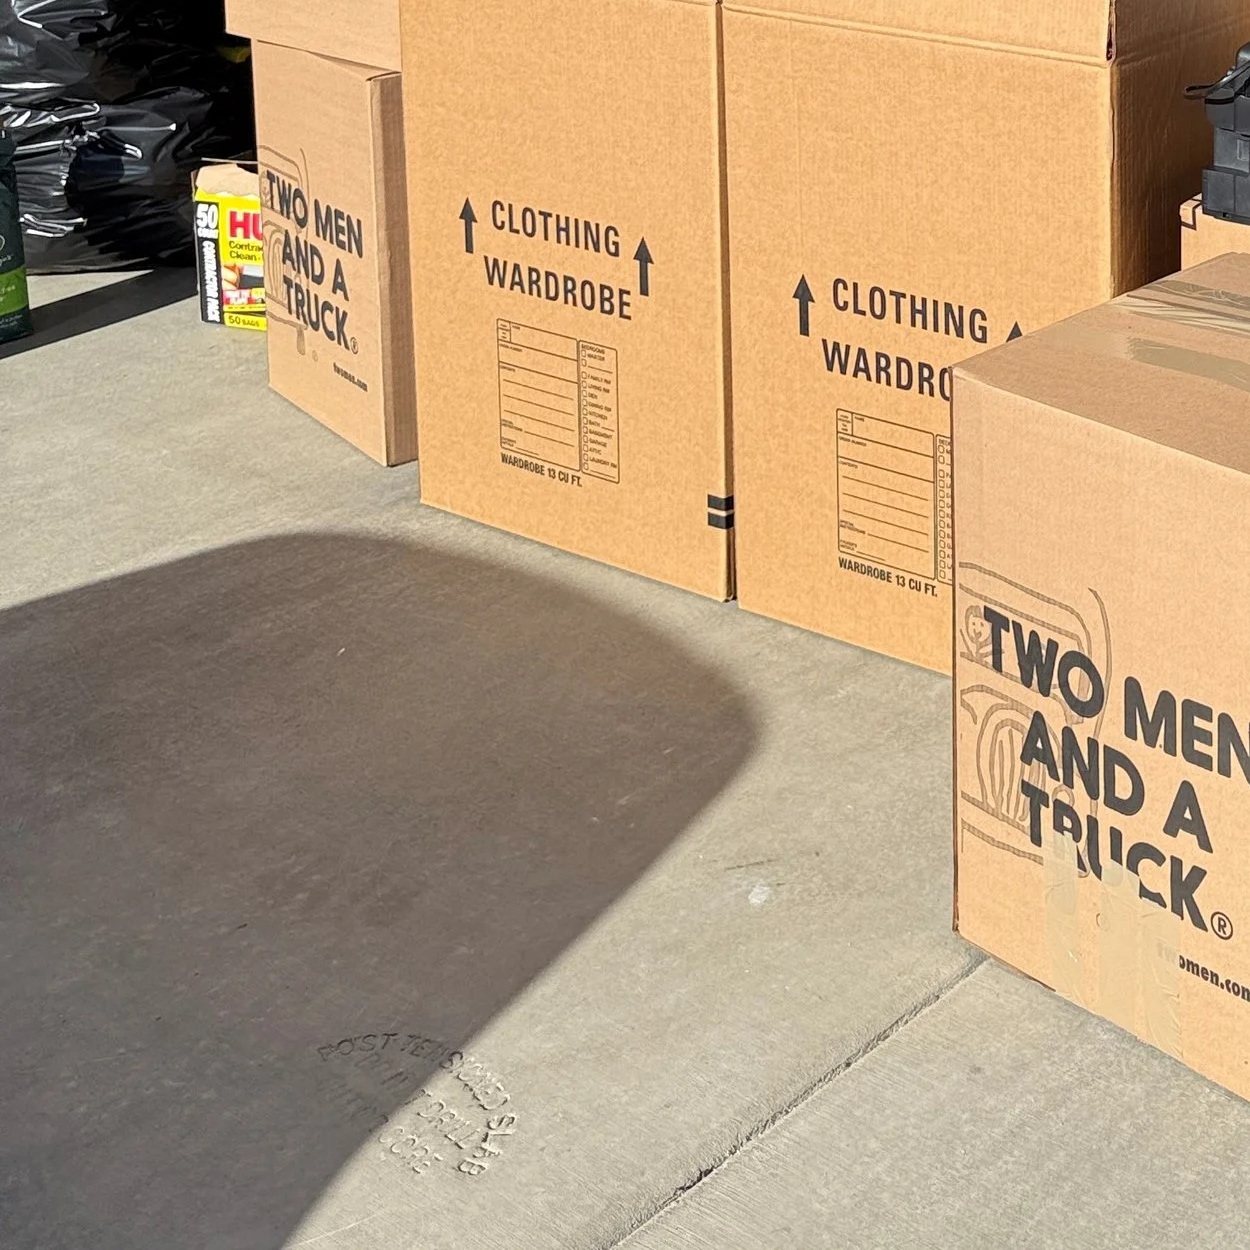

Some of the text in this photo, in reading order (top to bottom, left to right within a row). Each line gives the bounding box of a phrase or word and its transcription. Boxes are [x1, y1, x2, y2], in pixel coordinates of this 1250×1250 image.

[196, 203, 219, 229] 50
[266, 170, 363, 258] TWO MEN
[491, 200, 620, 258] CLOTHING
[282, 229, 350, 302] AND A
[483, 255, 632, 321] WARDROBE
[228, 315, 241, 325] 50
[832, 277, 988, 344] CLOTHING
[500, 452, 545, 475] WARDROBE
[547, 467, 556, 480] 13
[558, 470, 569, 484] CU
[838, 556, 938, 597] WARDROBE 13 CU FT.
[983, 605, 1102, 718] TWO
[1019, 710, 1213, 854] AND A
